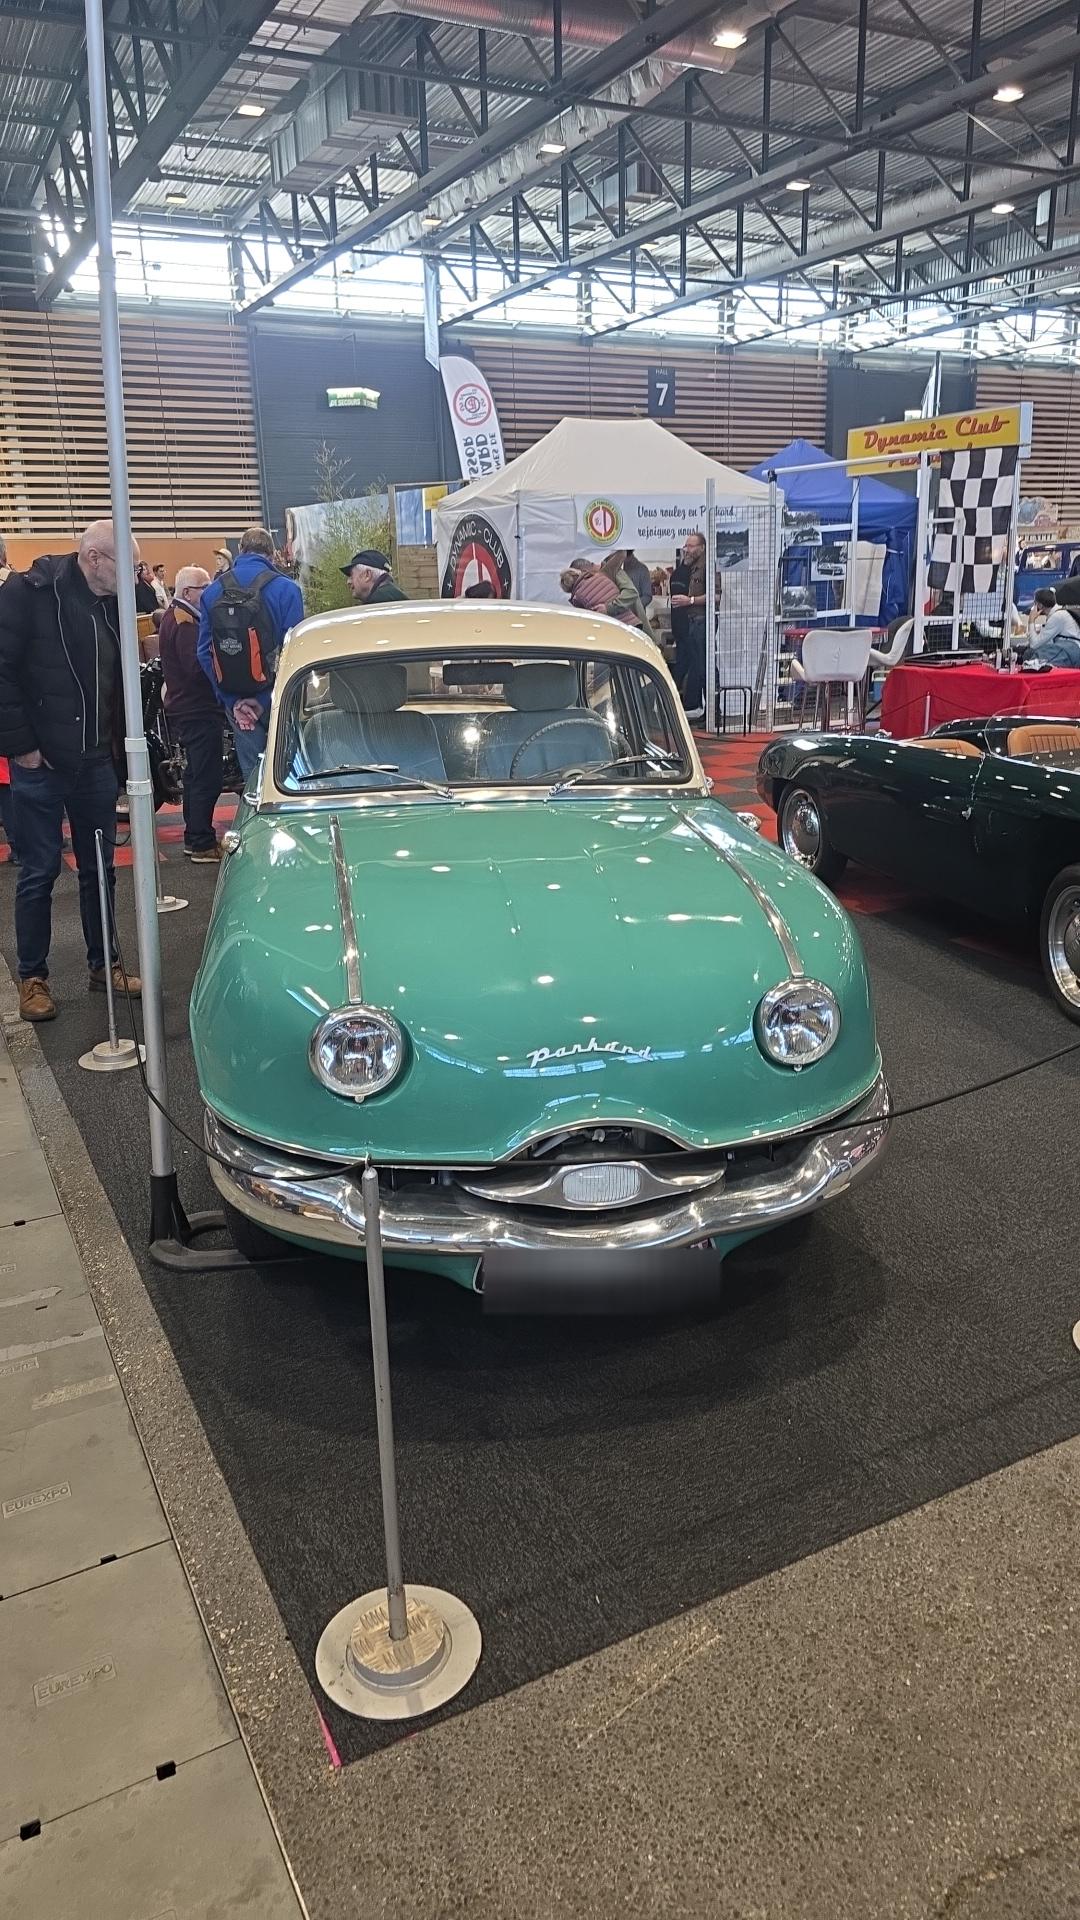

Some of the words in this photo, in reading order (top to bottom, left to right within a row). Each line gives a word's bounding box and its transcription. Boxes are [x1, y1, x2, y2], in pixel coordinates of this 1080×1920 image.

[655, 368, 668, 376] HALL
[655, 382, 668, 406] 7
[864, 422, 948, 452] Dynamic
[955, 415, 1010, 437] Club
[637, 505, 657, 518] Vous
[659, 505, 686, 520] roulez
[688, 508, 697, 517] en
[638, 525, 676, 539] rejoignez
[5, 1486, 69, 1513] EUREXPO
[38, 1663, 113, 1700] EUREXPO
